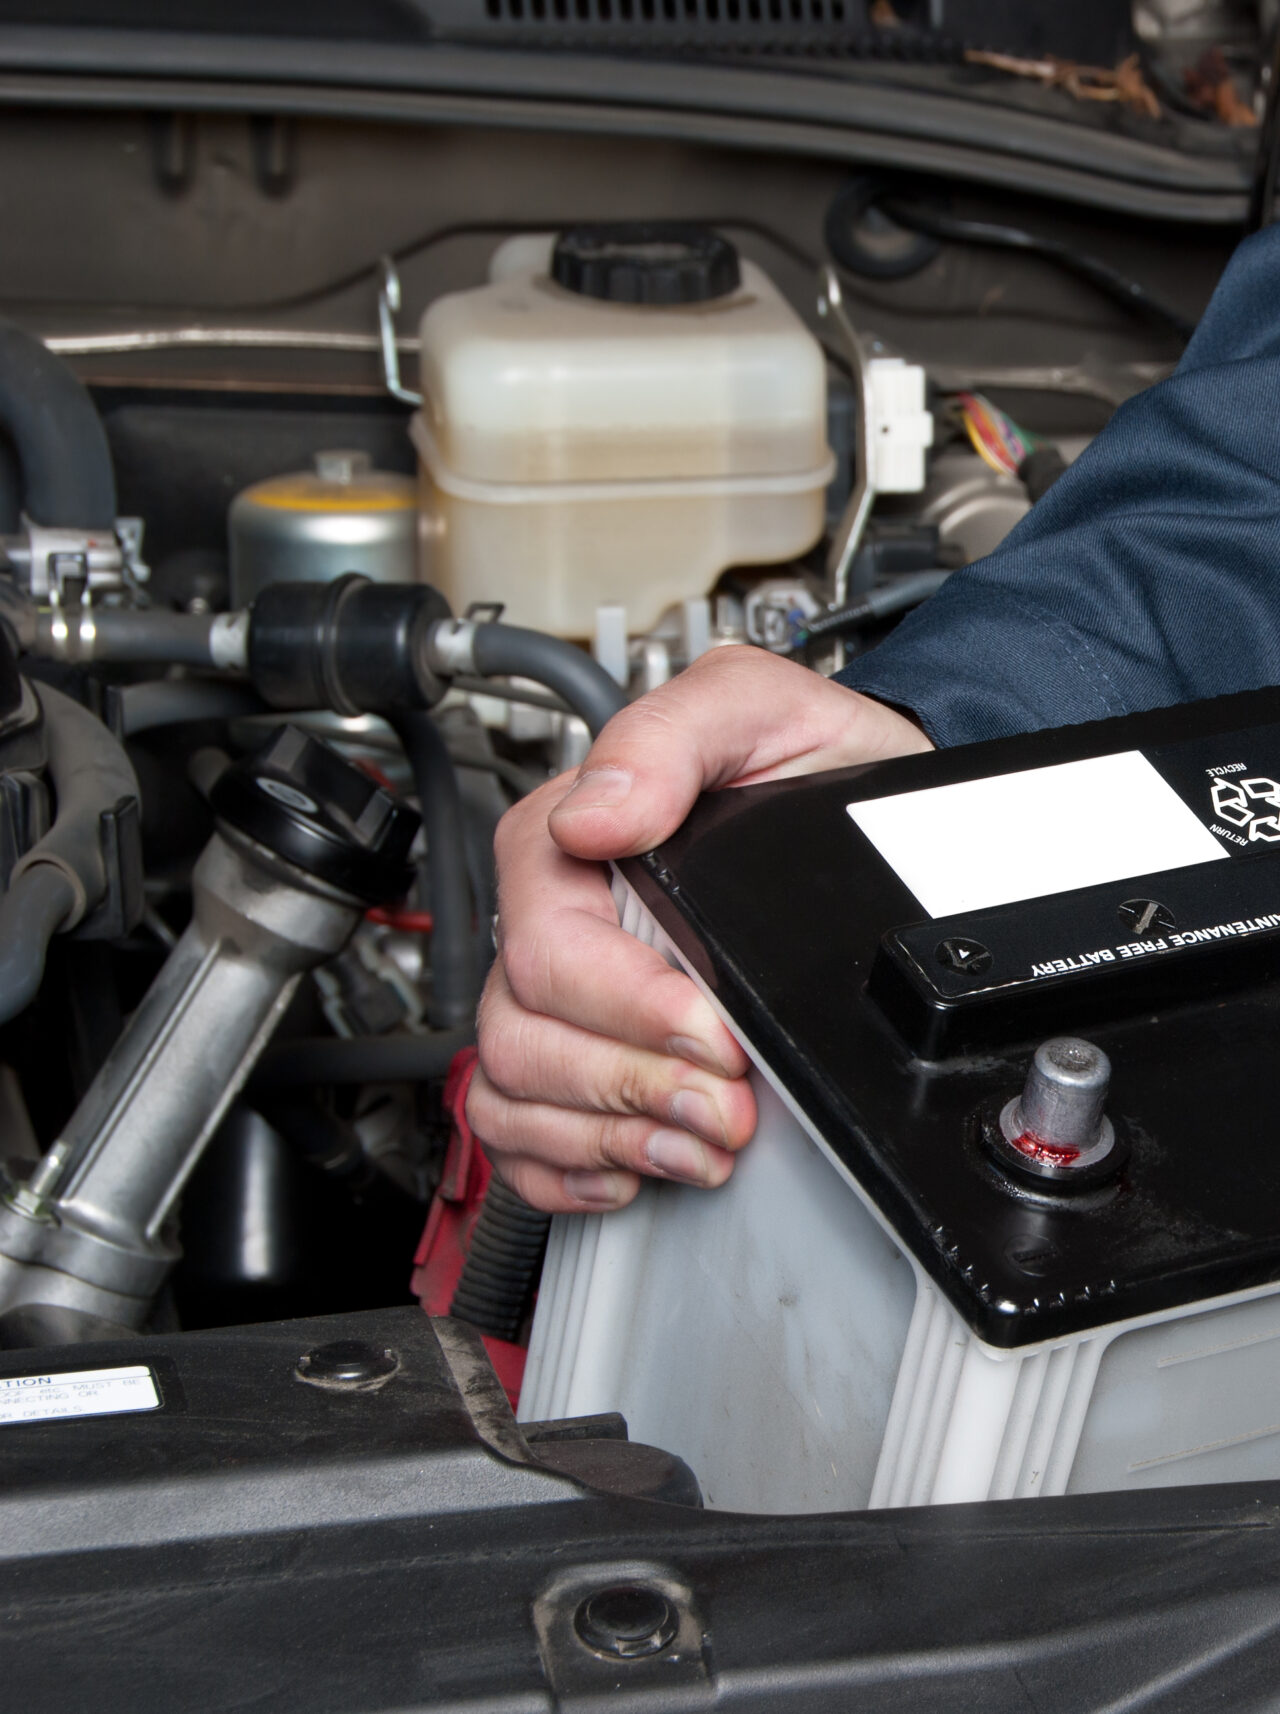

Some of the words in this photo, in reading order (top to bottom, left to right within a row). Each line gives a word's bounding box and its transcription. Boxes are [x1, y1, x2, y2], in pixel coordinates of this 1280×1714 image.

[1205, 762, 1248, 778] RECYCLE
[1209, 823, 1249, 847] RETURN
[1114, 934, 1169, 961] FREE
[1029, 948, 1116, 978] BATTERY
[0, 1376, 51, 1388] TION
[70, 1380, 113, 1391] MUST
